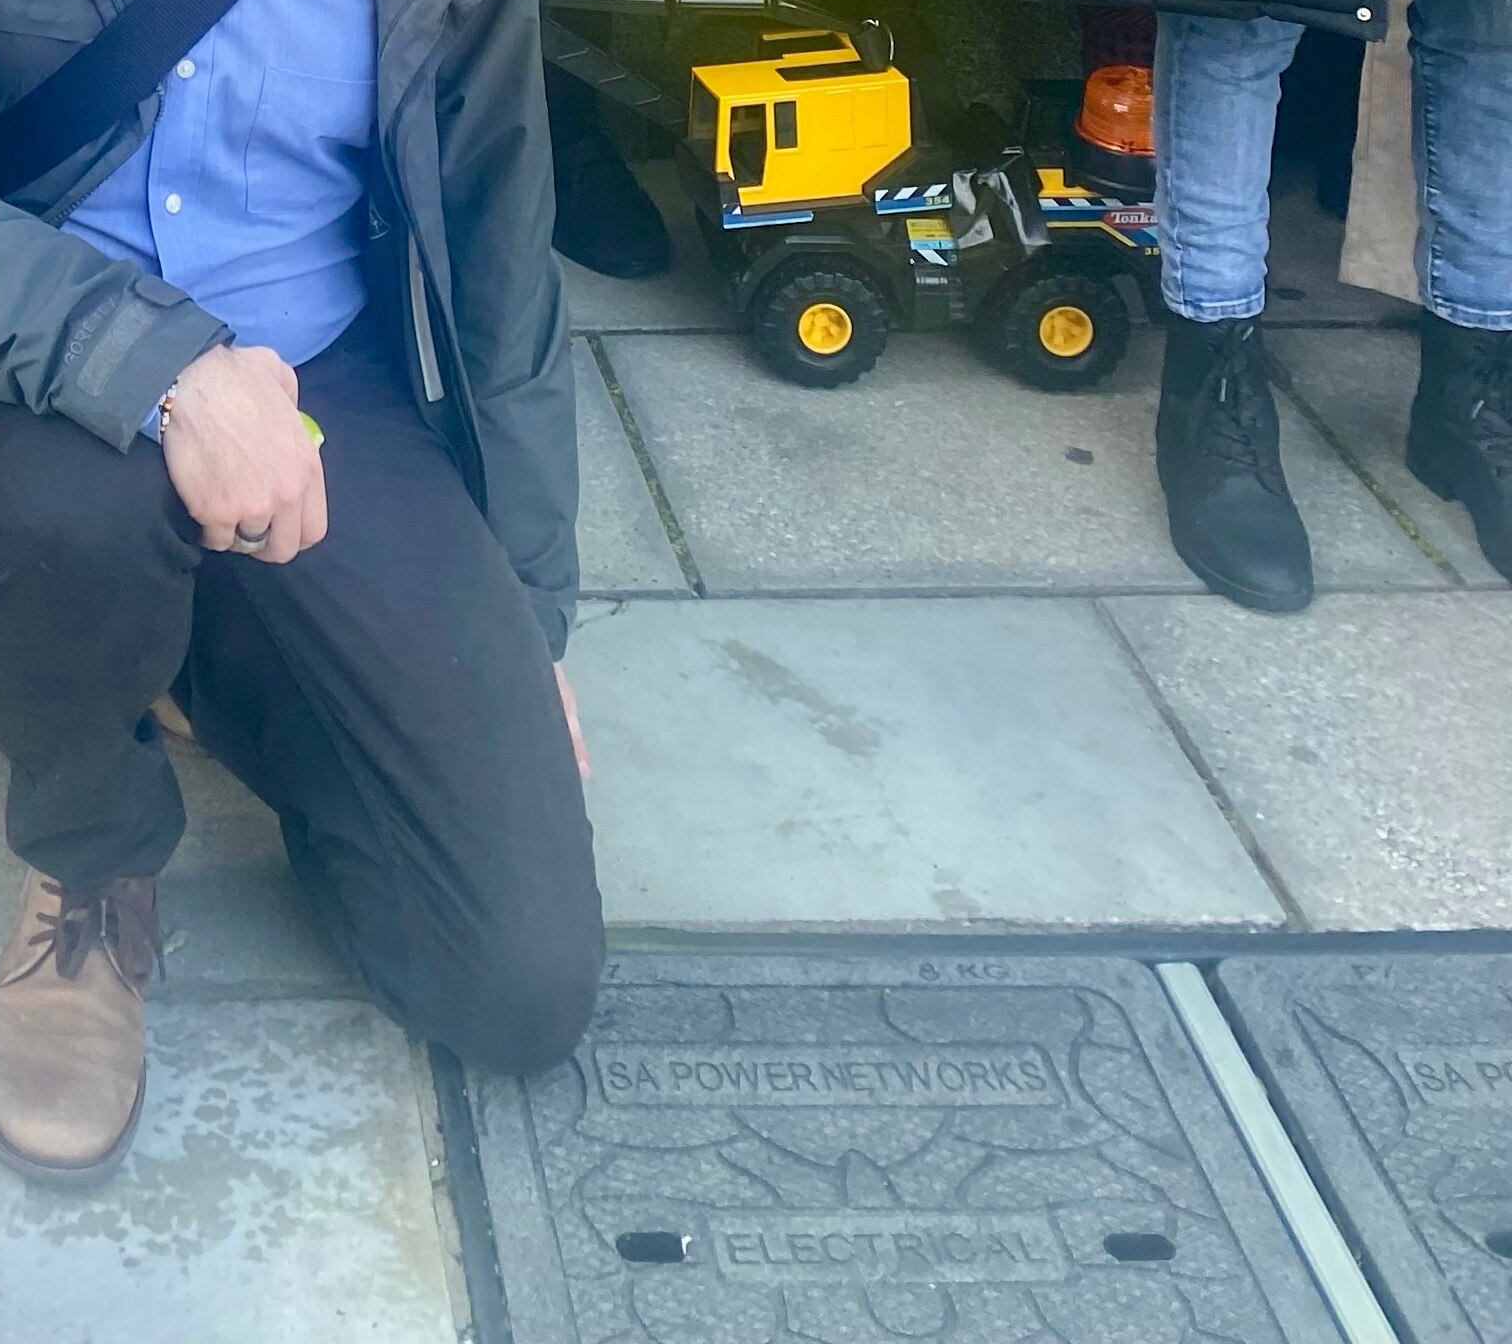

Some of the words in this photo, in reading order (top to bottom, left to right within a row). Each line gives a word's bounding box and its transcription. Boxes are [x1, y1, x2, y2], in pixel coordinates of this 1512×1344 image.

[1110, 211, 1159, 224] Tonka
[607, 1060, 660, 1093] SA
[669, 1060, 818, 1094] POWER
[821, 1060, 1047, 1094] NETWORKS
[1414, 1061, 1476, 1093] SA
[726, 1232, 1050, 1264] ELECTRICAL
